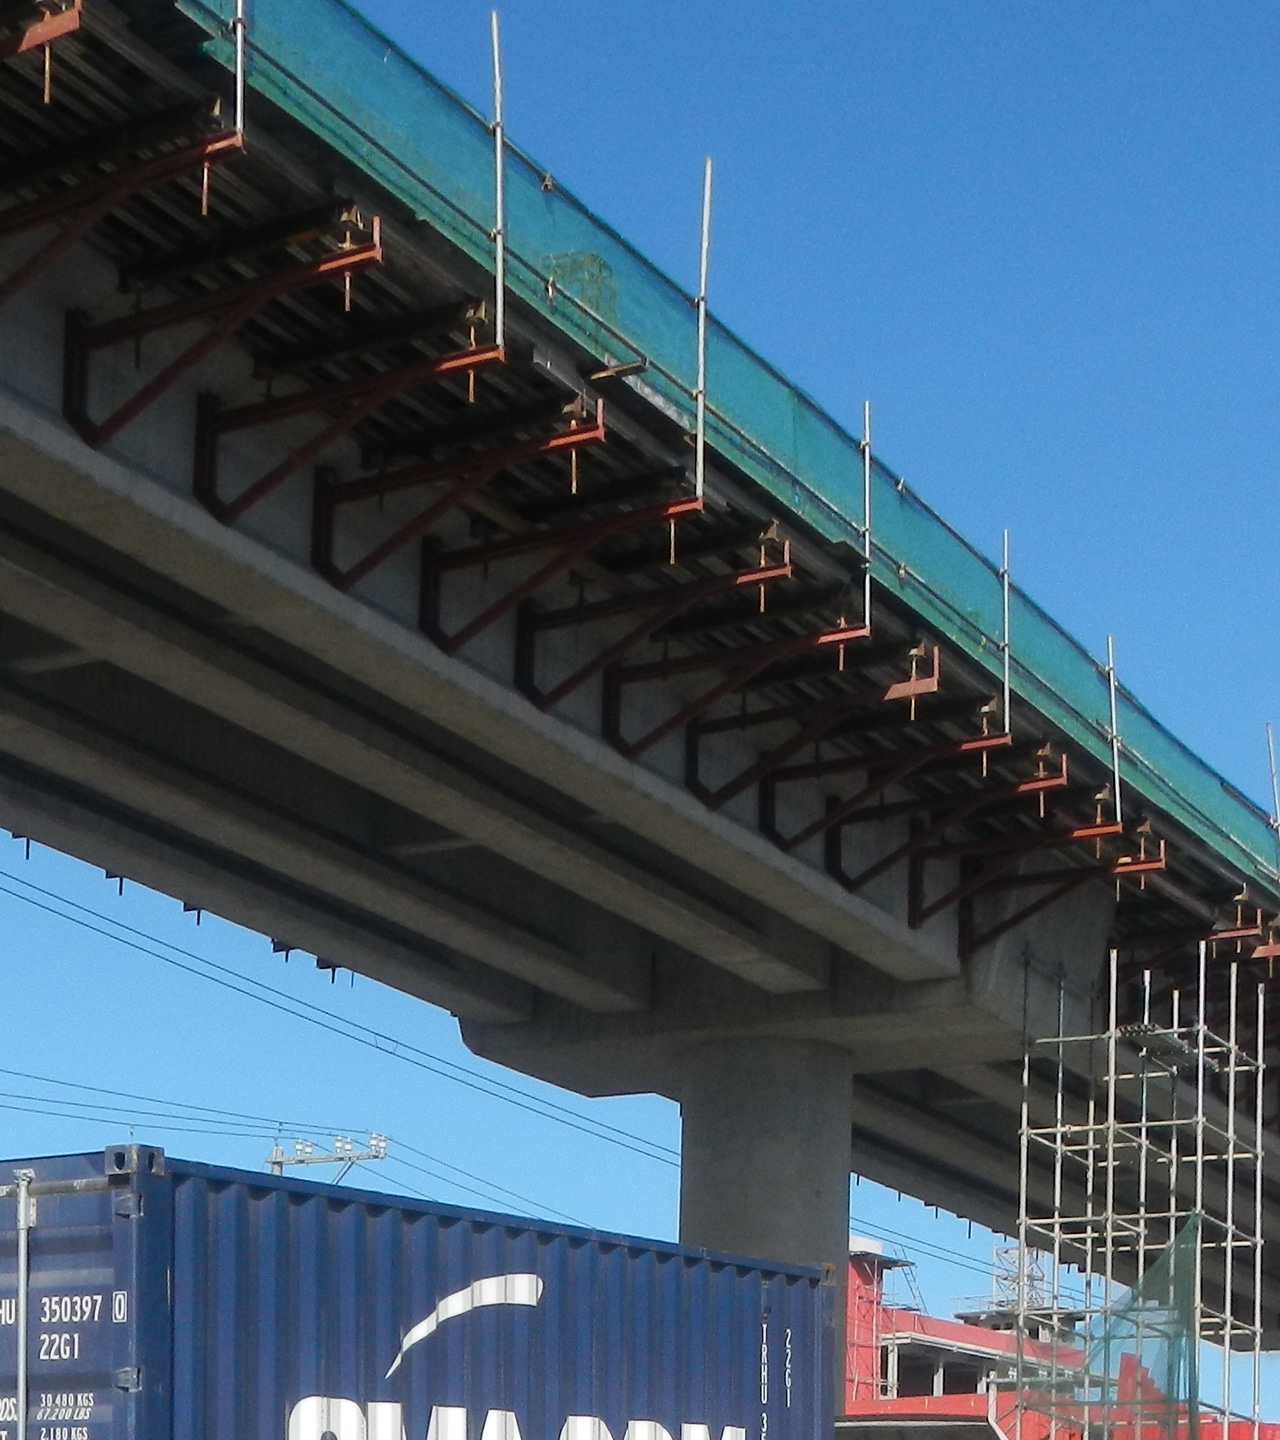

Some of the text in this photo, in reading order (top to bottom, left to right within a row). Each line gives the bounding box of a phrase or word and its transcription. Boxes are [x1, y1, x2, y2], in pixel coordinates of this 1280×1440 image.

[40, 1295, 102, 1323] 350397
[39, 1333, 79, 1360] 22G1
[40, 1393, 94, 1408] 30.480 KGS
[73, 1407, 92, 1421] LBS
[40, 1427, 88, 1440] 2.180 KGS
